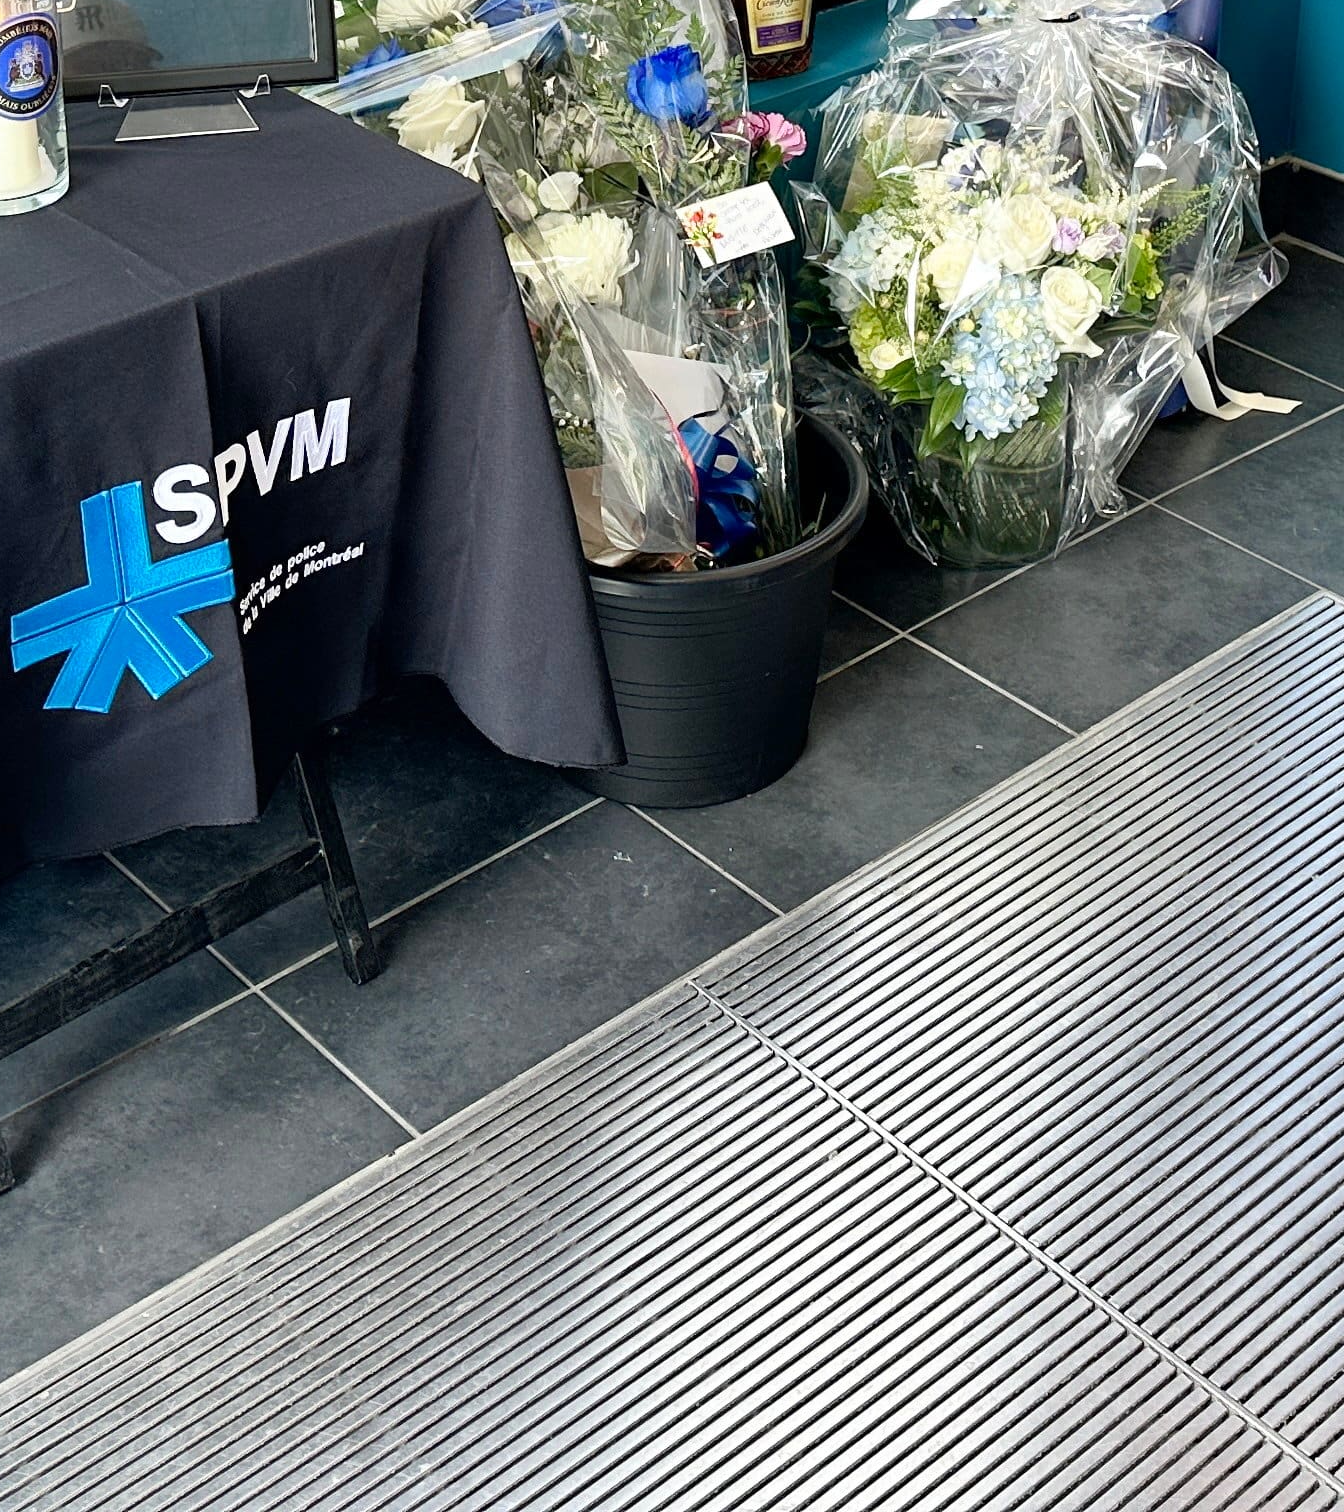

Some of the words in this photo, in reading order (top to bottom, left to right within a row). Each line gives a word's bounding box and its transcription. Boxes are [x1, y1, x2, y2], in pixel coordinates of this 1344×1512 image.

[153, 397, 351, 544] SPVM
[260, 584, 281, 609] Ville
[285, 572, 299, 590] de
[303, 541, 365, 578] Montréal
[269, 564, 283, 582] de
[287, 541, 326, 573] police
